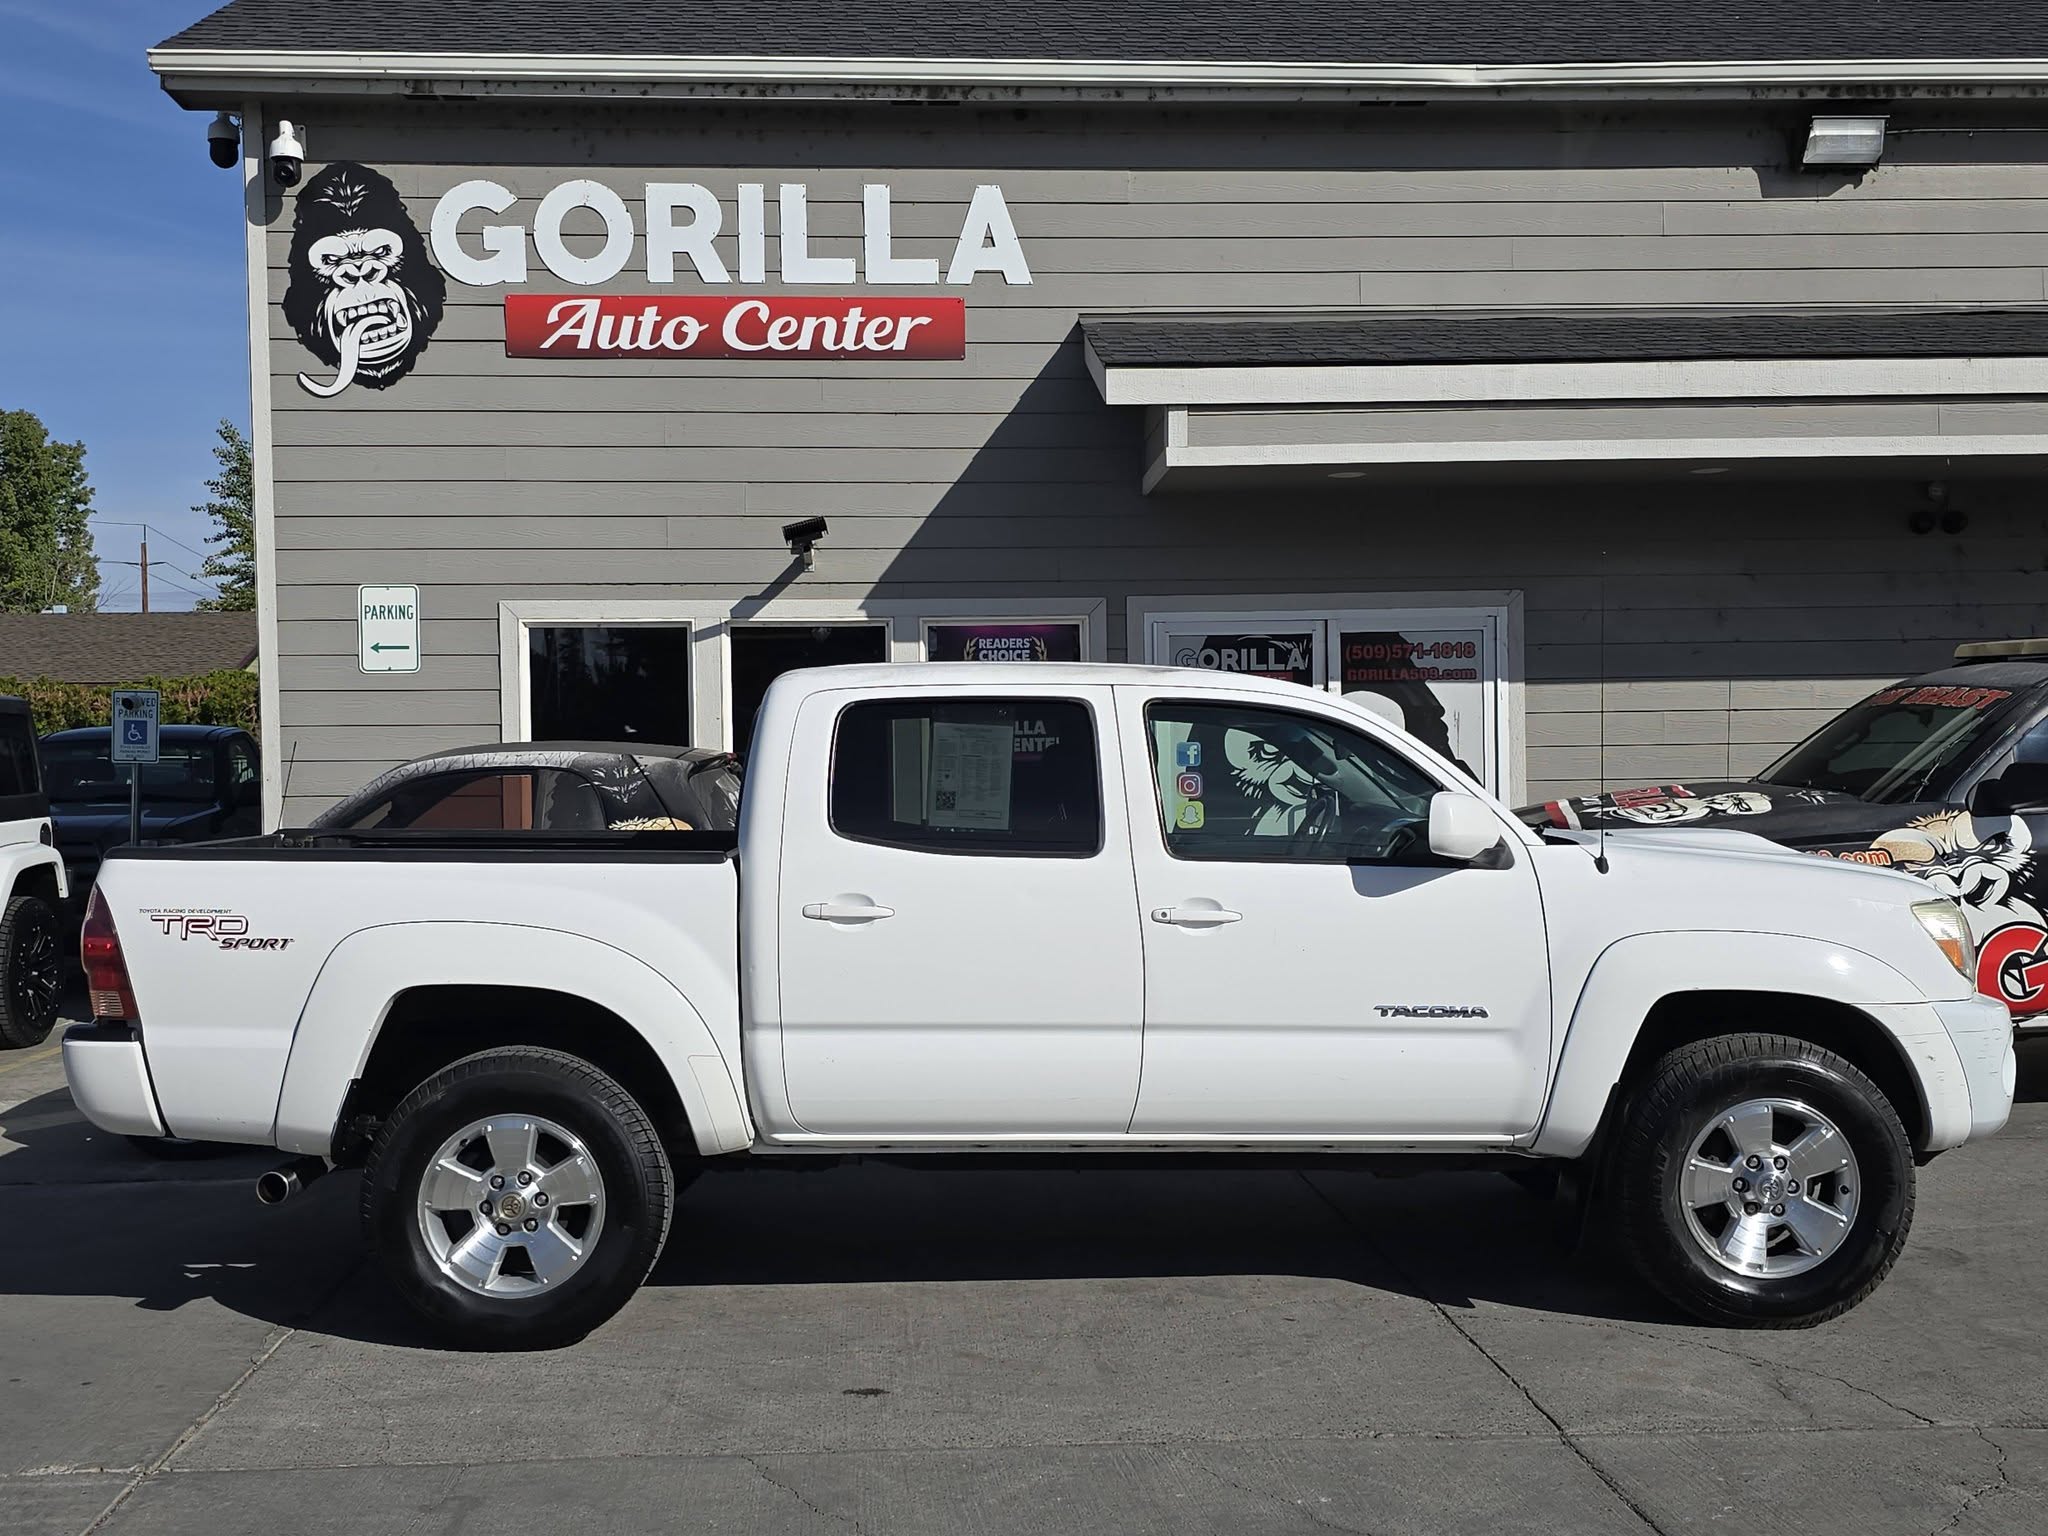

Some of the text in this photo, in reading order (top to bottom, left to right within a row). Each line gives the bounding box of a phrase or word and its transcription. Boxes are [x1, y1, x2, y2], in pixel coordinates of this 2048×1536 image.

[430, 179, 1034, 286] GORILLA
[540, 299, 933, 351] Auto Center
[364, 605, 414, 620] PARKING
[979, 650, 1031, 661] CHOICE
[1175, 647, 1306, 670] GORILLA
[1346, 641, 1477, 661] (509)571-1818
[1346, 667, 1478, 681] GORILLA509.com
[1899, 686, 2013, 710] BEAST
[118, 709, 153, 719] PARKING
[151, 914, 249, 941] TRD
[219, 937, 291, 951] SPORT
[1373, 1004, 1489, 1019] TACOMA
